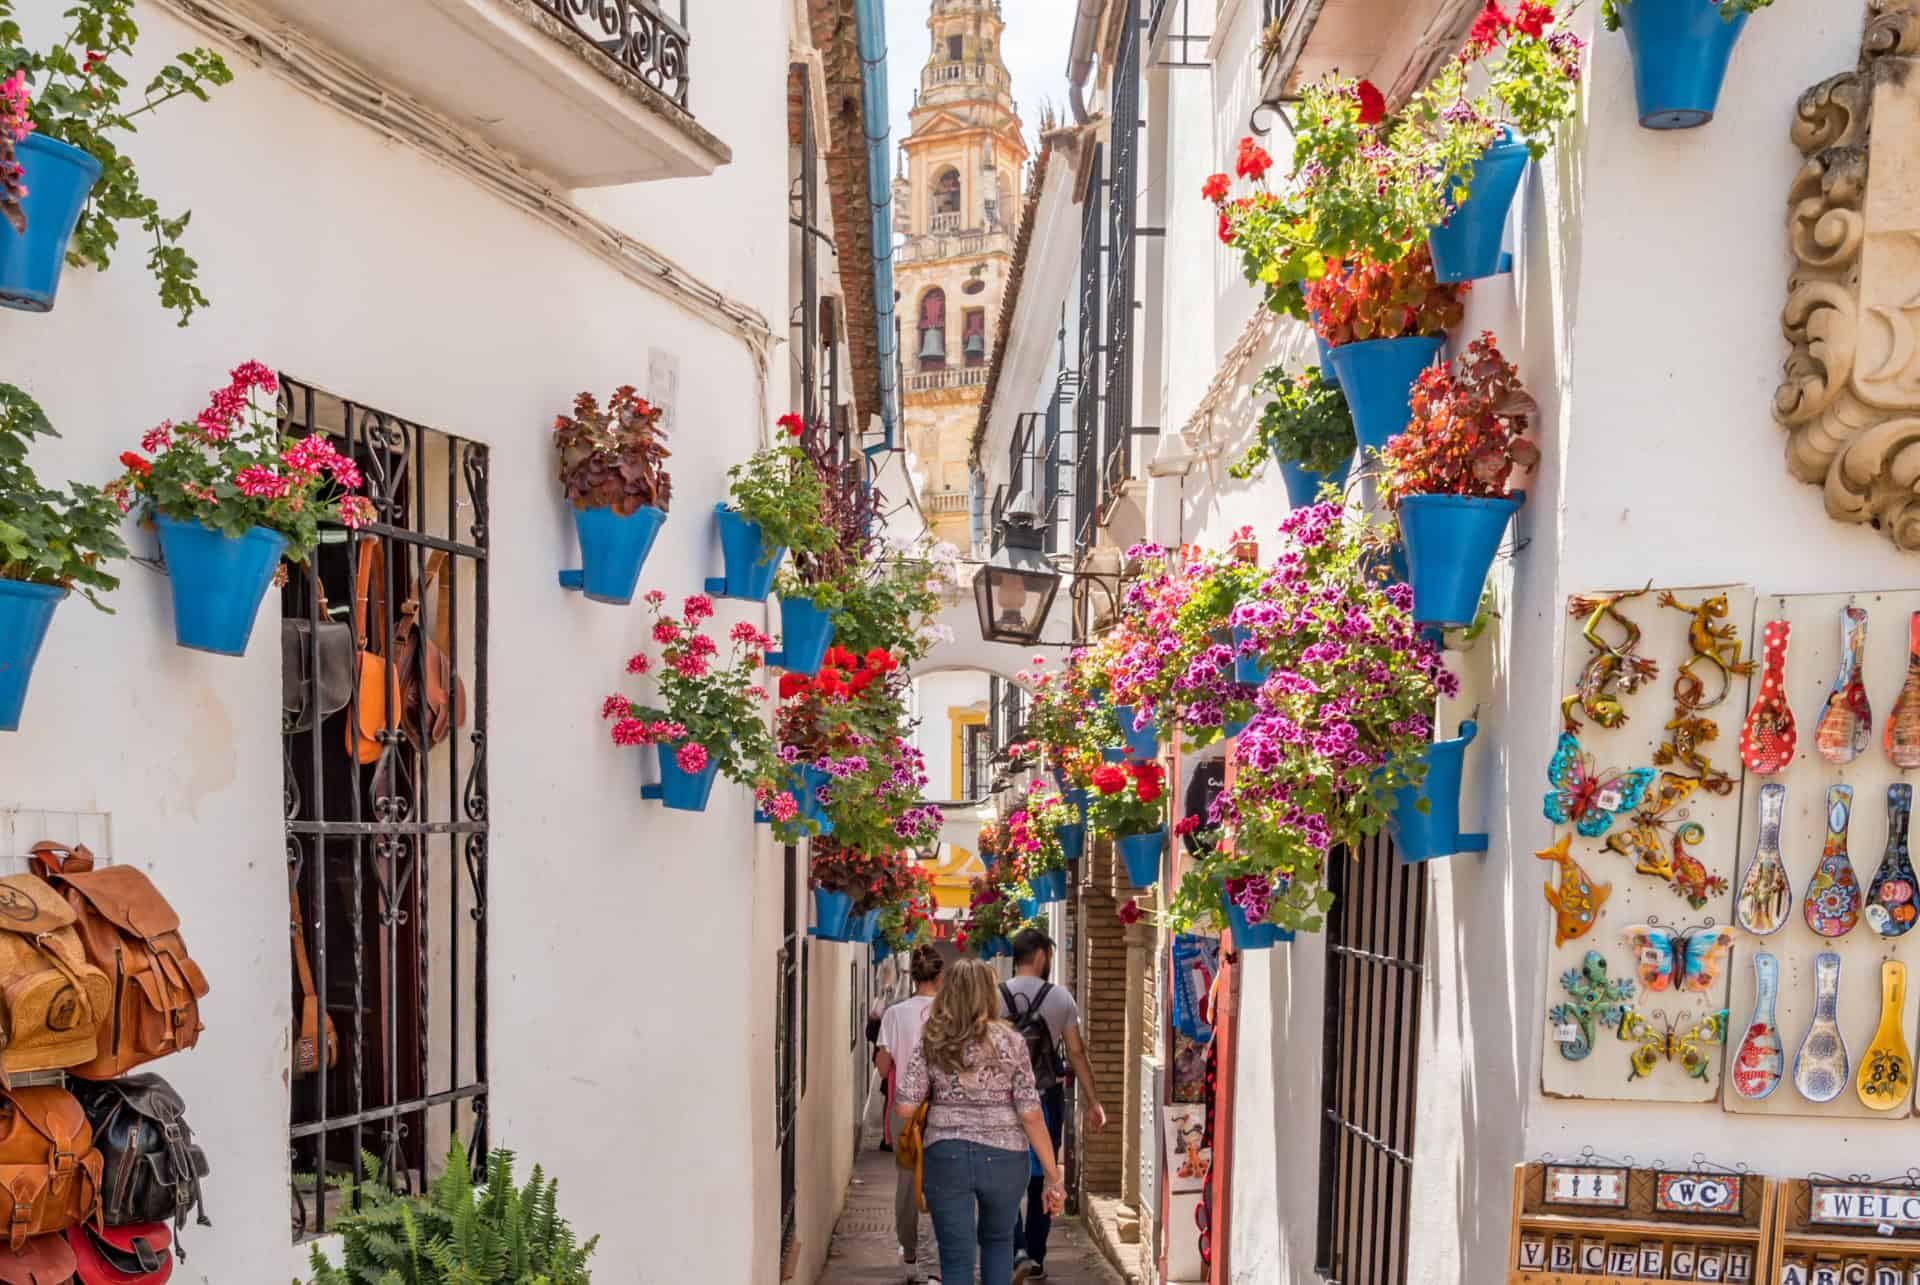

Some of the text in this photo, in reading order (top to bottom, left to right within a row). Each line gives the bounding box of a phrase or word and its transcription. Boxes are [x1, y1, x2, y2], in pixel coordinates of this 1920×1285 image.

[1680, 1184, 1717, 1203] WC
[1554, 1246, 1570, 1266] B
[1585, 1246, 1603, 1268] C
[1644, 1251, 1661, 1273] E
[1673, 1252, 1691, 1274] G
[1700, 1258, 1718, 1280] G
[1730, 1254, 1748, 1278] H
[1783, 1267, 1800, 1285] A
[1846, 1267, 1865, 1285] C
